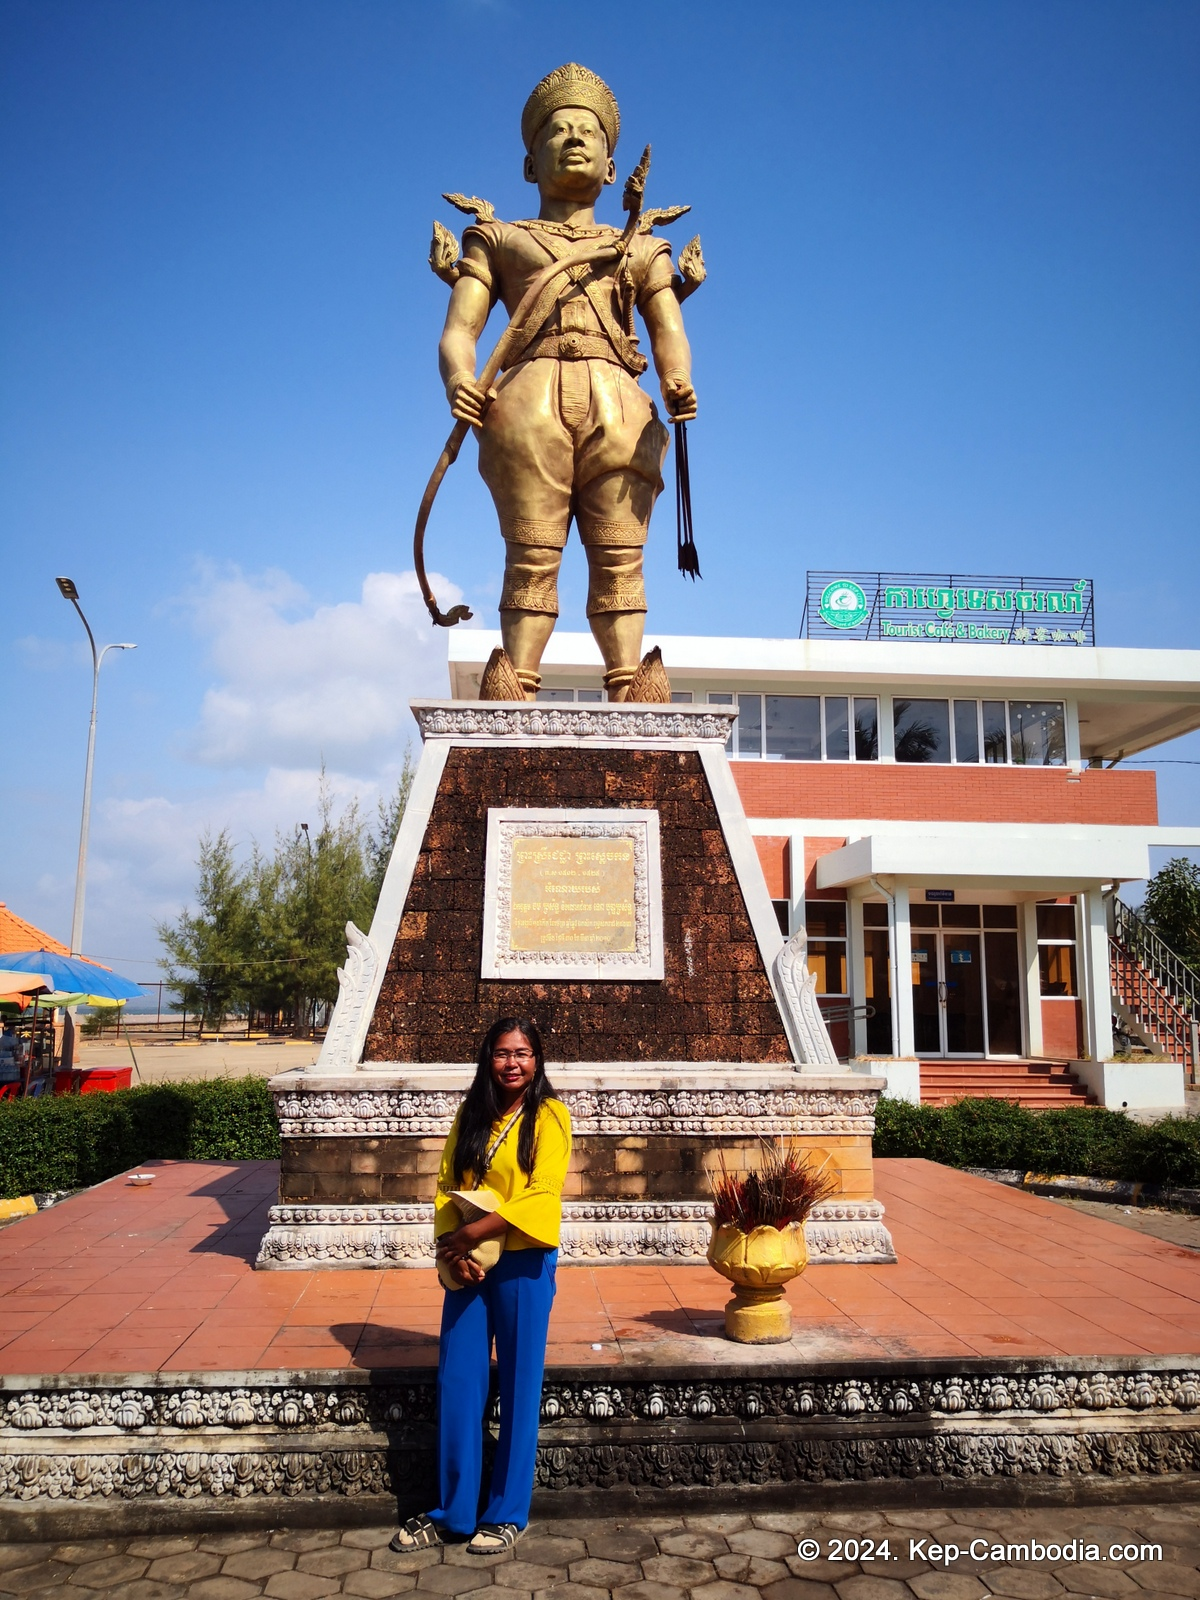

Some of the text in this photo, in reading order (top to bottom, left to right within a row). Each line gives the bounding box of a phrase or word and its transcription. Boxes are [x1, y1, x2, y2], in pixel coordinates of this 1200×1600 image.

[881, 621, 923, 637] Tourist
[925, 622, 953, 639] Café
[956, 624, 966, 638] &
[968, 624, 1010, 644] Bakery
